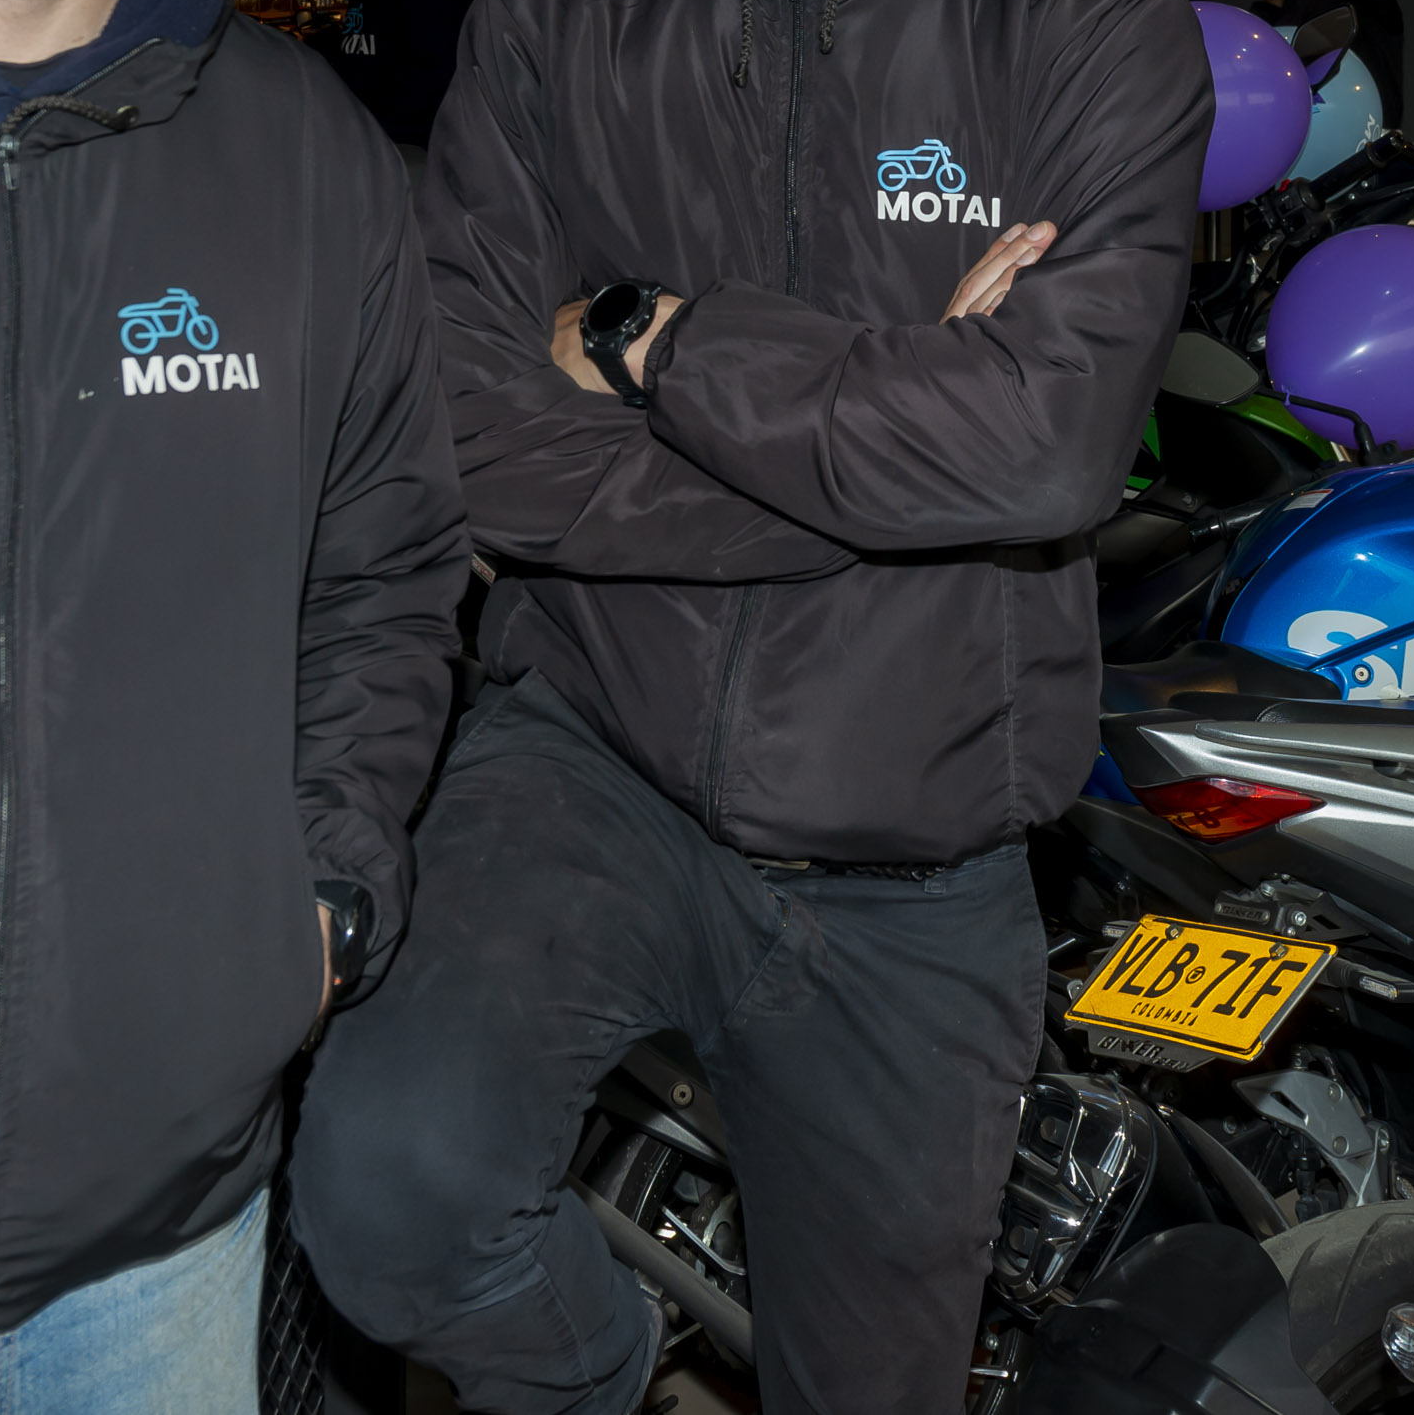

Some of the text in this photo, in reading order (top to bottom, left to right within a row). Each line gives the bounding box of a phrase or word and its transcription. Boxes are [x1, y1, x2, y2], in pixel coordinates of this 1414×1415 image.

[877, 190, 1001, 228] MOTAI
[121, 353, 260, 397] MOTAI
[1103, 934, 1308, 1019] VLB 71F
[1131, 1002, 1198, 1027] COLOMBIA
